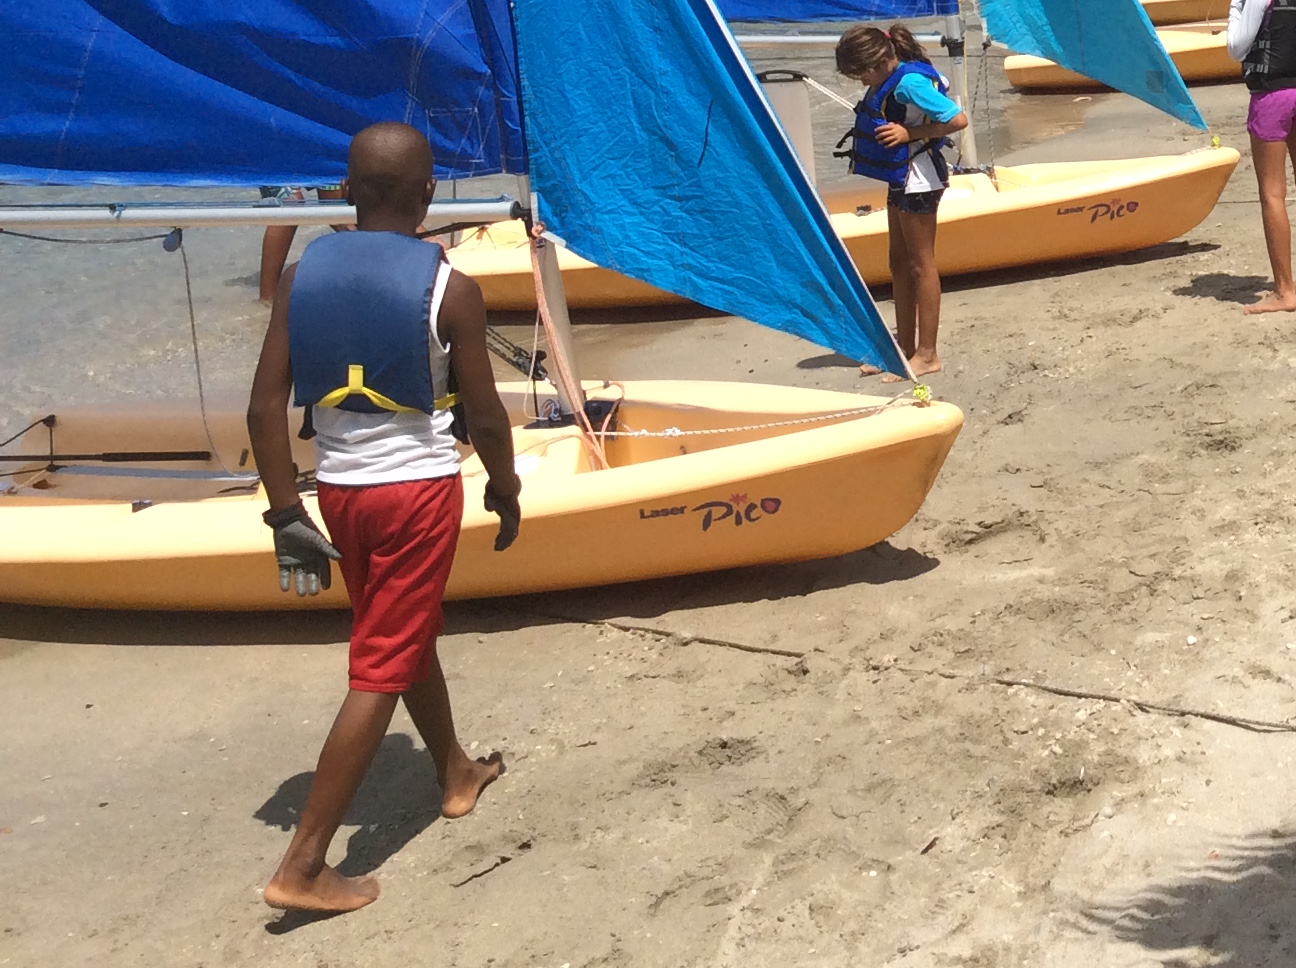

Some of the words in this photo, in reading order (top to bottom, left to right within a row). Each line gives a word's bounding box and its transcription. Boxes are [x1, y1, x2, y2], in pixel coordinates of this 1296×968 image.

[1087, 198, 1139, 224] Pico
[639, 505, 687, 519] Laser
[691, 493, 782, 532] Pico
